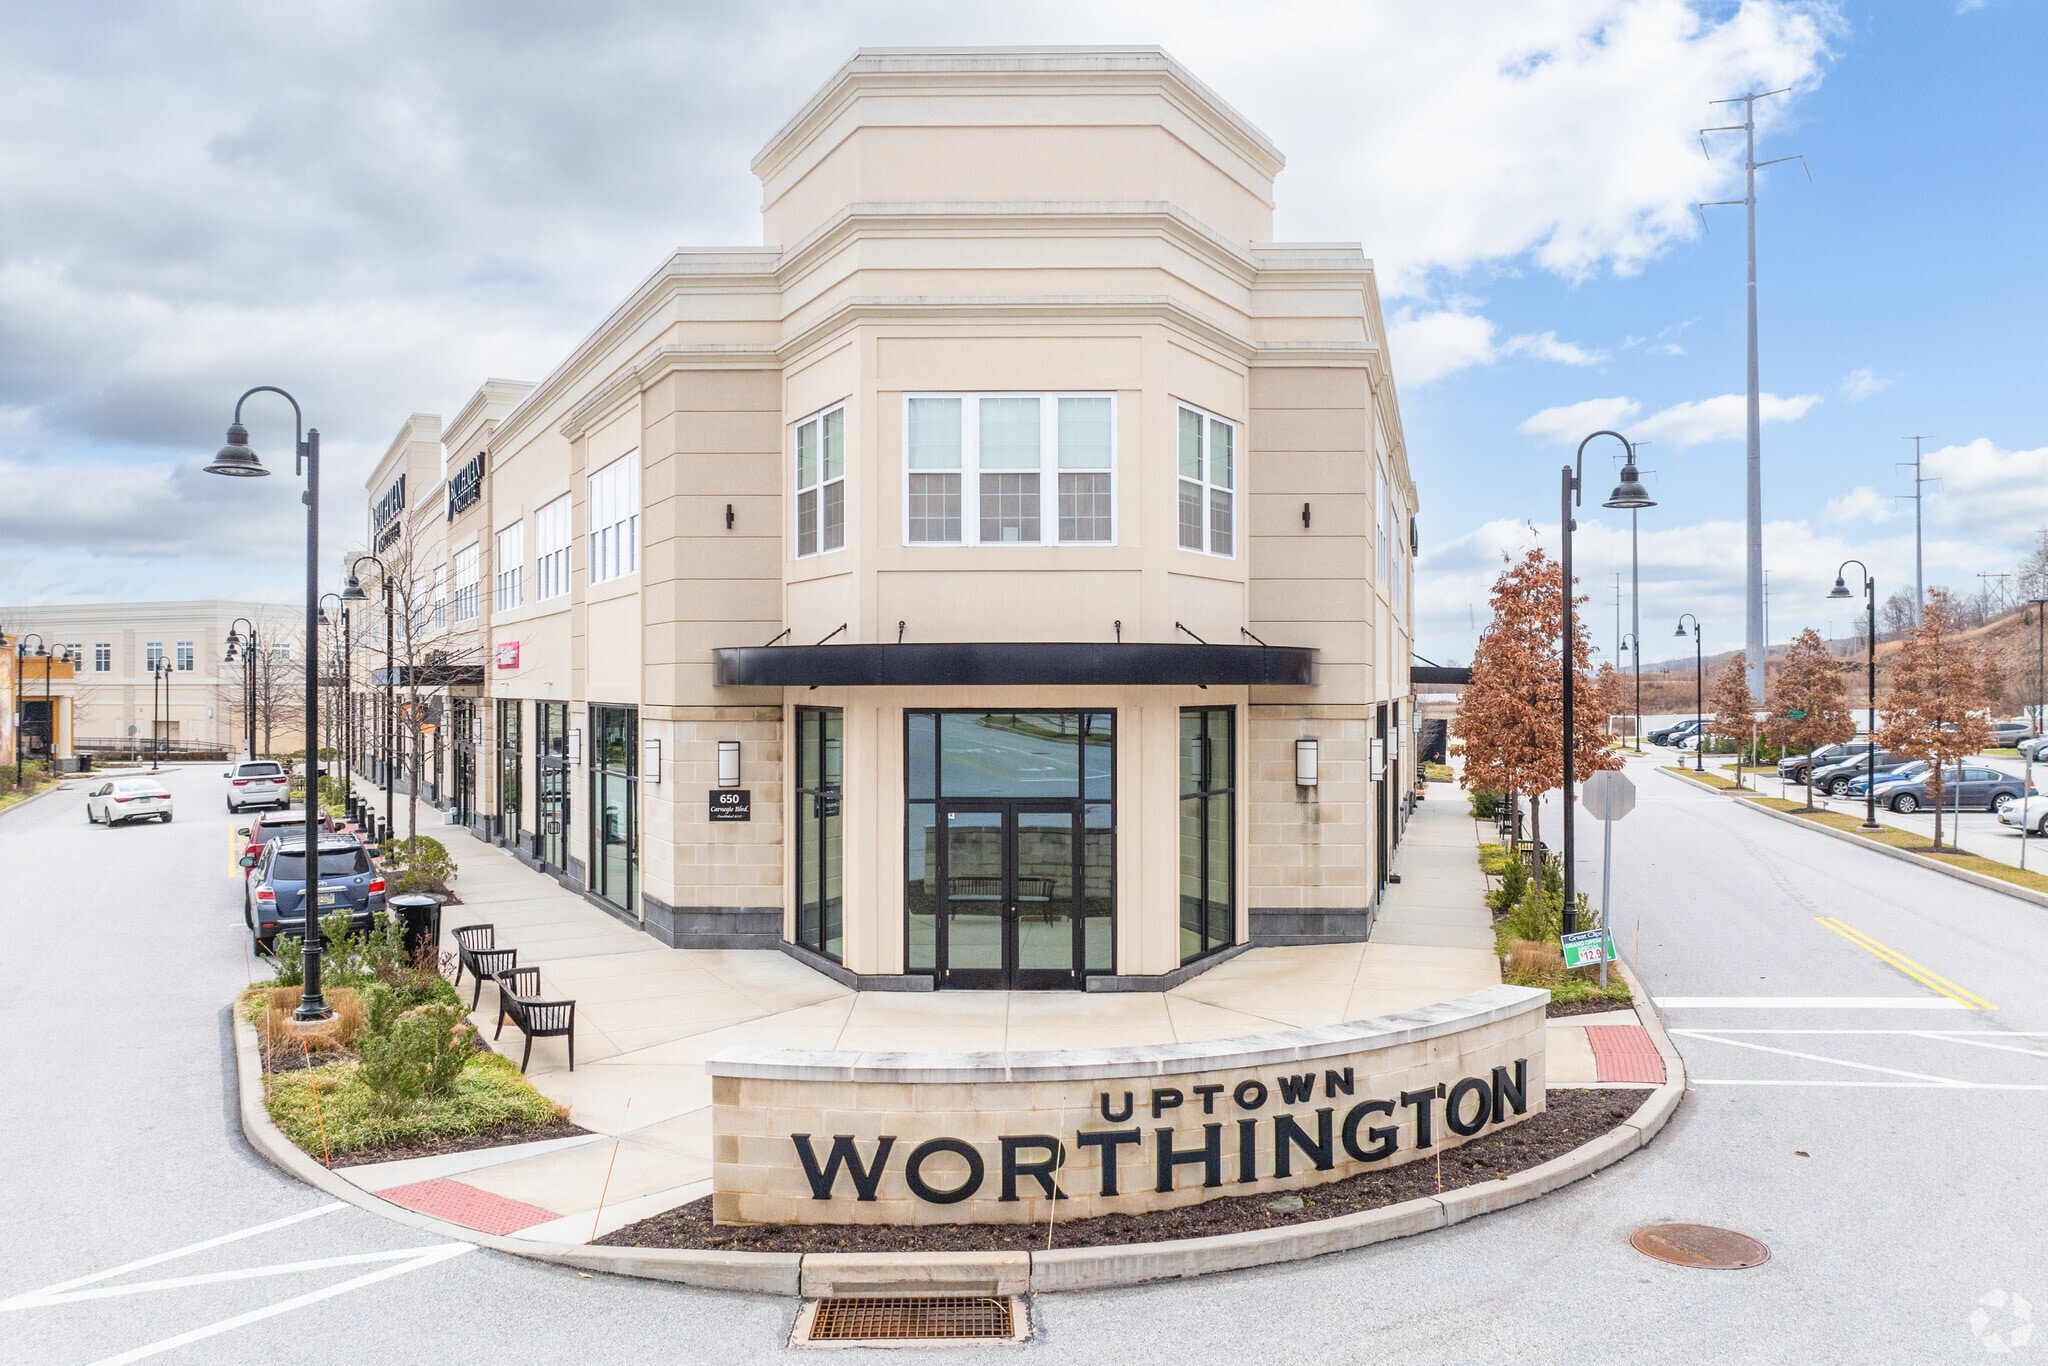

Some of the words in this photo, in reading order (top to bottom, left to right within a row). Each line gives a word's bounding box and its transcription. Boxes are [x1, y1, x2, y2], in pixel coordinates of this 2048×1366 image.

[720, 794, 740, 804] 650
[710, 806, 734, 814] Carnegie
[1580, 949, 1602, 960] $12.9
[1101, 1067, 1354, 1122] UPTOWN
[791, 1058, 1528, 1204] WORTHINGTON
